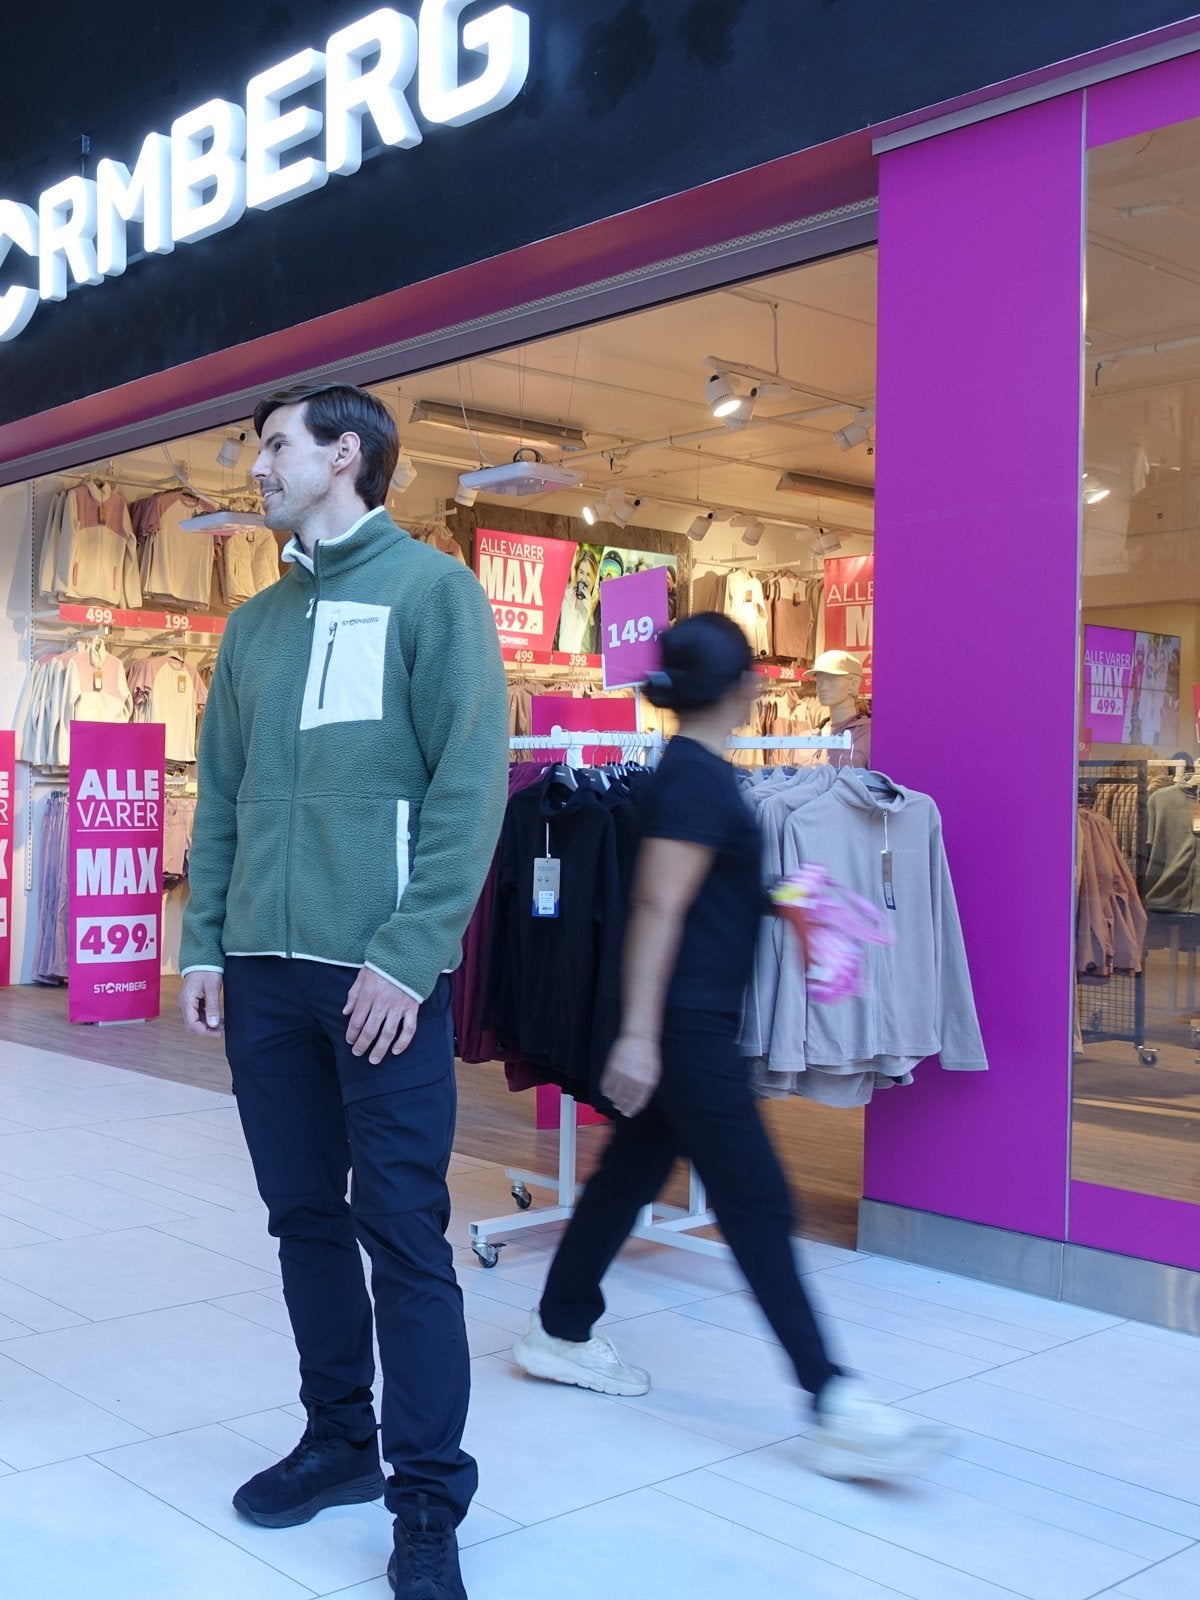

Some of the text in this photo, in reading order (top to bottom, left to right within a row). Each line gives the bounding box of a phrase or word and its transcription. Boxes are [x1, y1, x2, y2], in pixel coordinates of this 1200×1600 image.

[480, 537, 544, 561] ALLE VARER
[480, 554, 544, 606] MAX
[1085, 649, 1131, 667] ALLE VARER
[1091, 665, 1124, 699] MAX
[76, 769, 160, 800] ALLE
[76, 801, 159, 828] VARER
[76, 847, 158, 896] MAX
[80, 923, 155, 955] 499,-
[93, 981, 147, 994] STORMBERG
